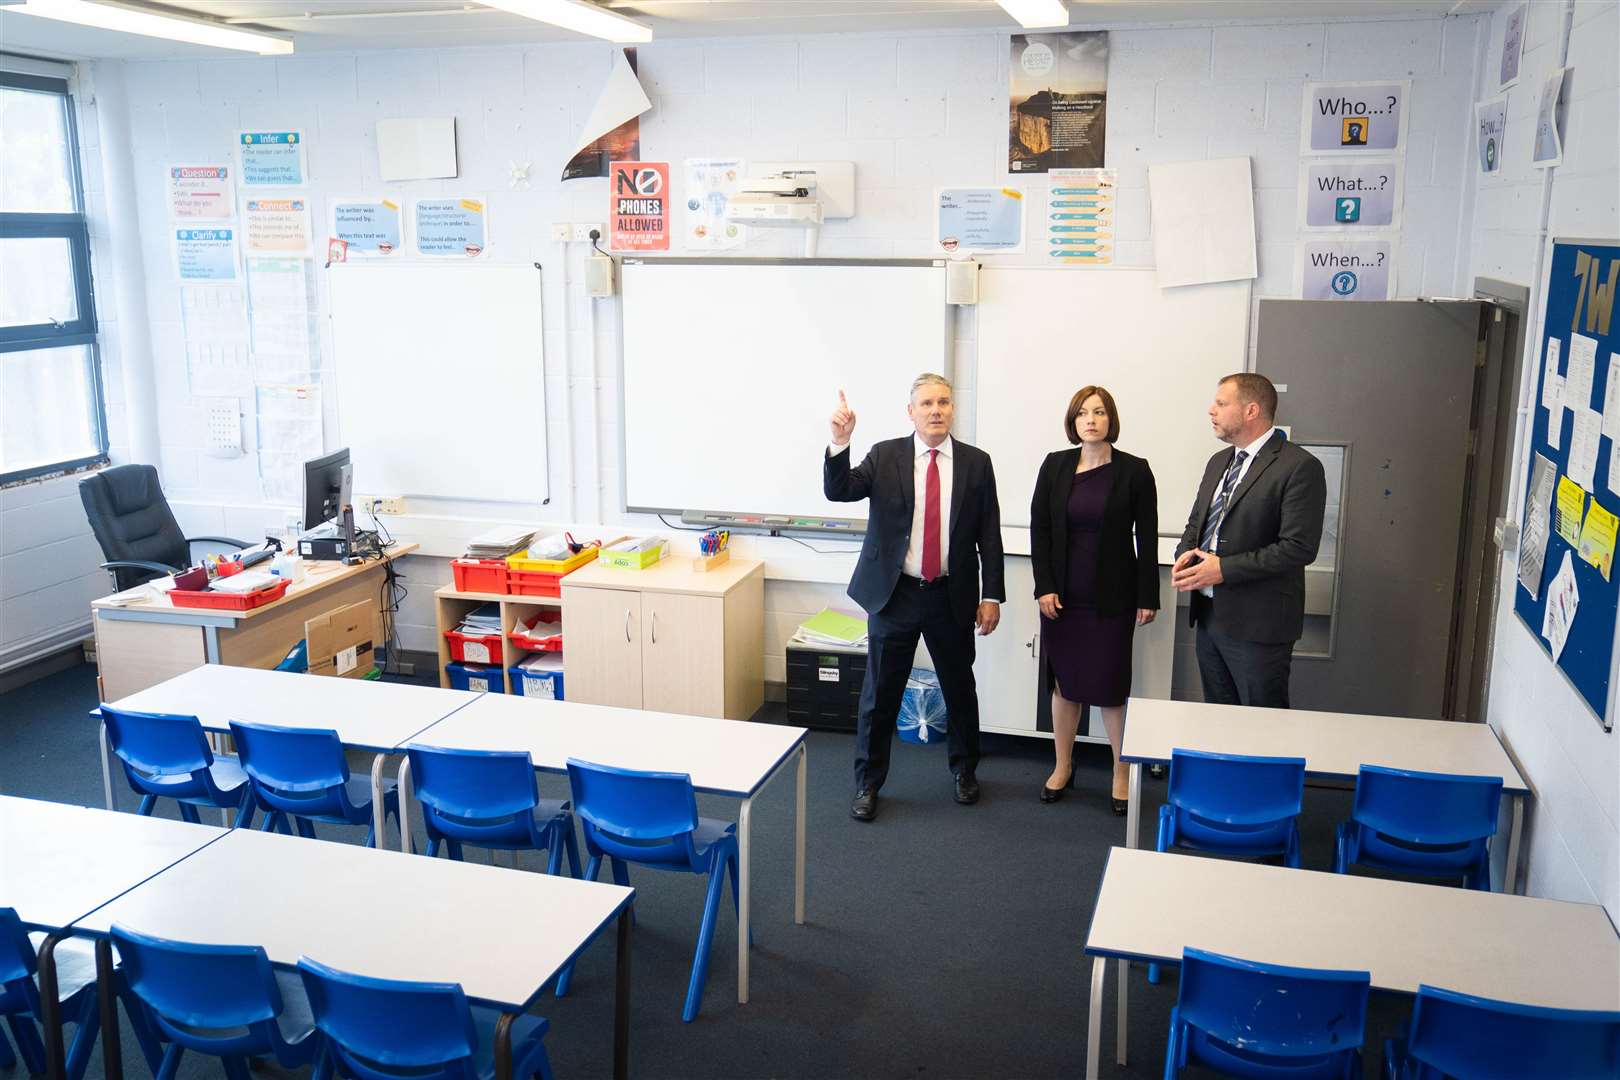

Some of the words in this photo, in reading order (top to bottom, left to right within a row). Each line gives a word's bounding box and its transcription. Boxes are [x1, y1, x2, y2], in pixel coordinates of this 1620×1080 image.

[1318, 96, 1397, 115] Who...?
[260, 134, 280, 143] Infer
[182, 168, 217, 177] Question
[1318, 176, 1388, 191] What...?
[620, 200, 660, 214] PHONES
[618, 218, 662, 231] ALLOWED
[192, 231, 216, 240] Clarify
[1311, 252, 1384, 267] When...?
